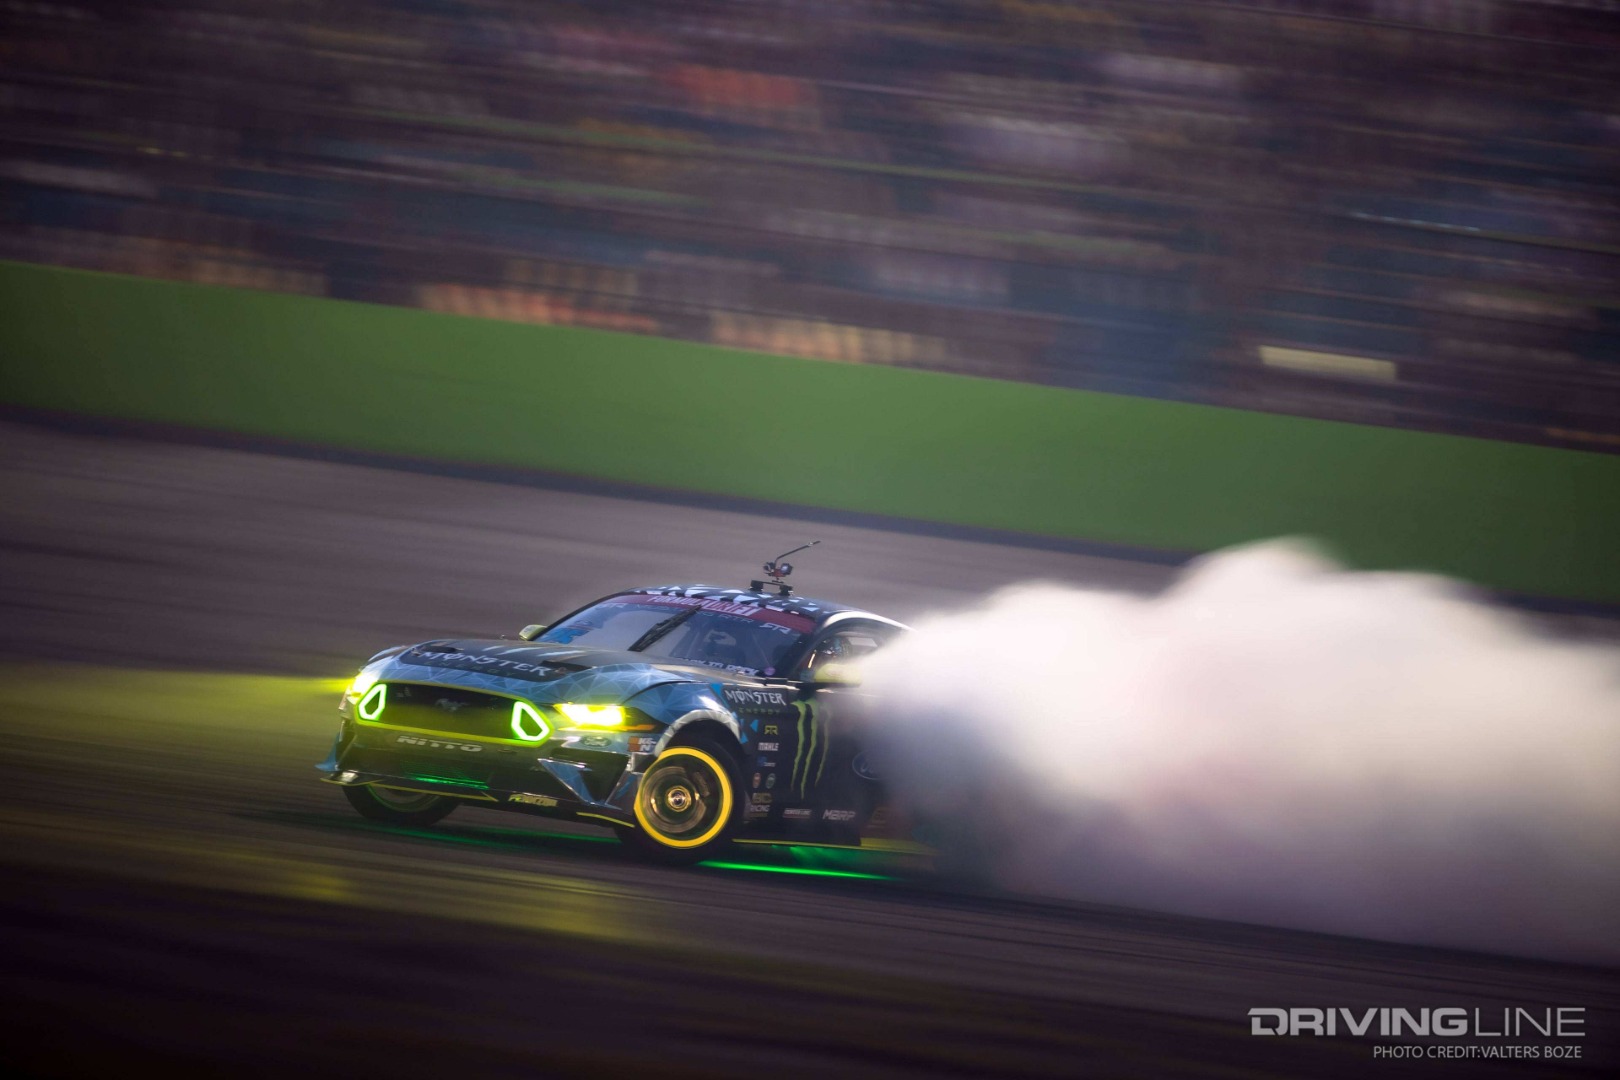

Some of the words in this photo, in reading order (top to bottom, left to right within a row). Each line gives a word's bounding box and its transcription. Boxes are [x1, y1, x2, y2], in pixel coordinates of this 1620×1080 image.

[418, 651, 551, 677] MONSTER
[724, 688, 787, 706] MONSTER
[396, 735, 483, 753] NITTO
